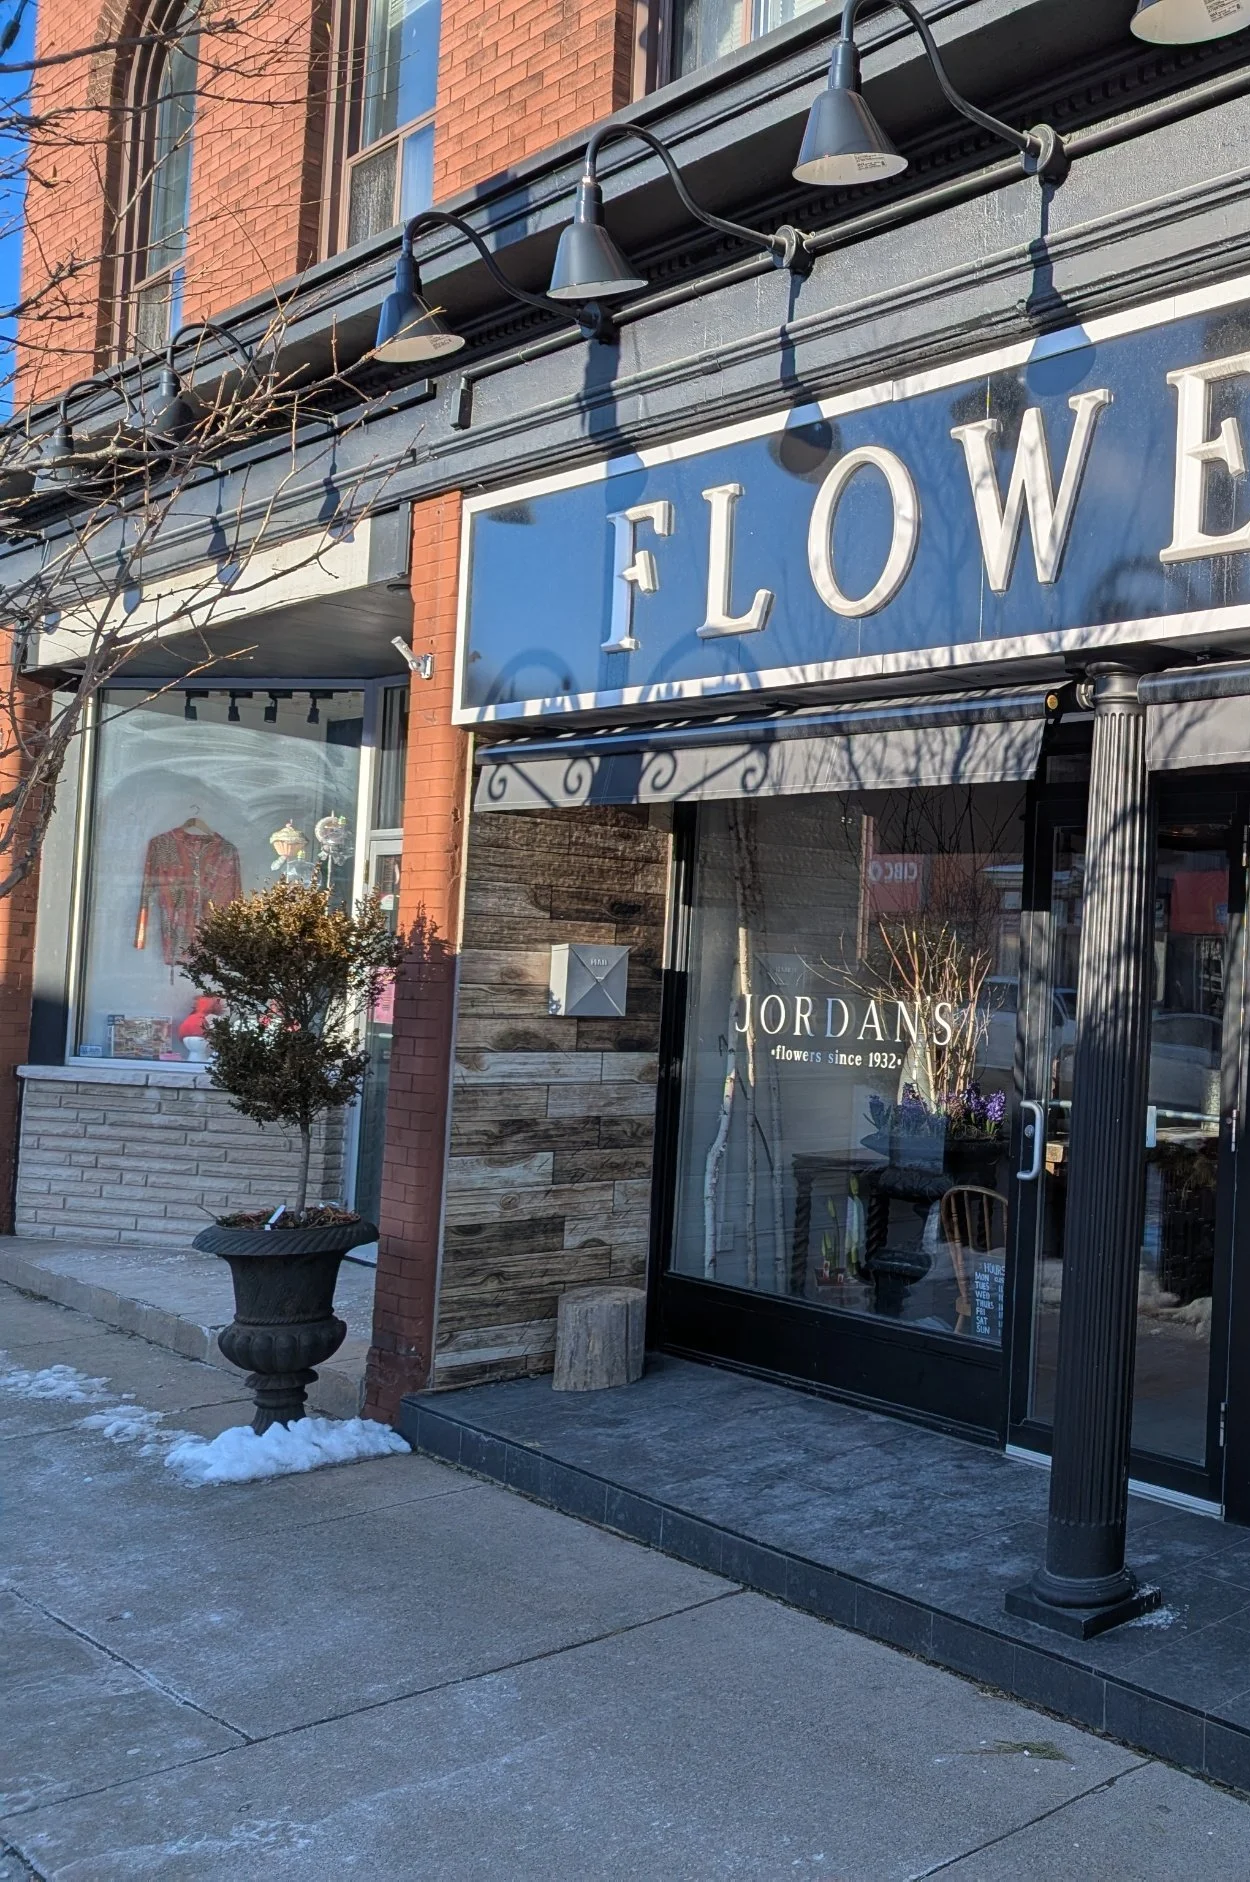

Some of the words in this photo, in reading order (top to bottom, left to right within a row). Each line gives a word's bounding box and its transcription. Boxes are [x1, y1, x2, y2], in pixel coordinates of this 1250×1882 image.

[735, 993, 953, 1046] JORDAN'S
[828, 1049, 862, 1066] since
[984, 1262, 1005, 1276] HOURS
[975, 1271, 990, 1282] MON
[974, 1281, 990, 1291] TUES
[975, 1290, 991, 1300] WED
[975, 1299, 995, 1310] THURS
[975, 1307, 986, 1316] FRI
[976, 1316, 988, 1326] SAT
[976, 1325, 991, 1335] SUN
